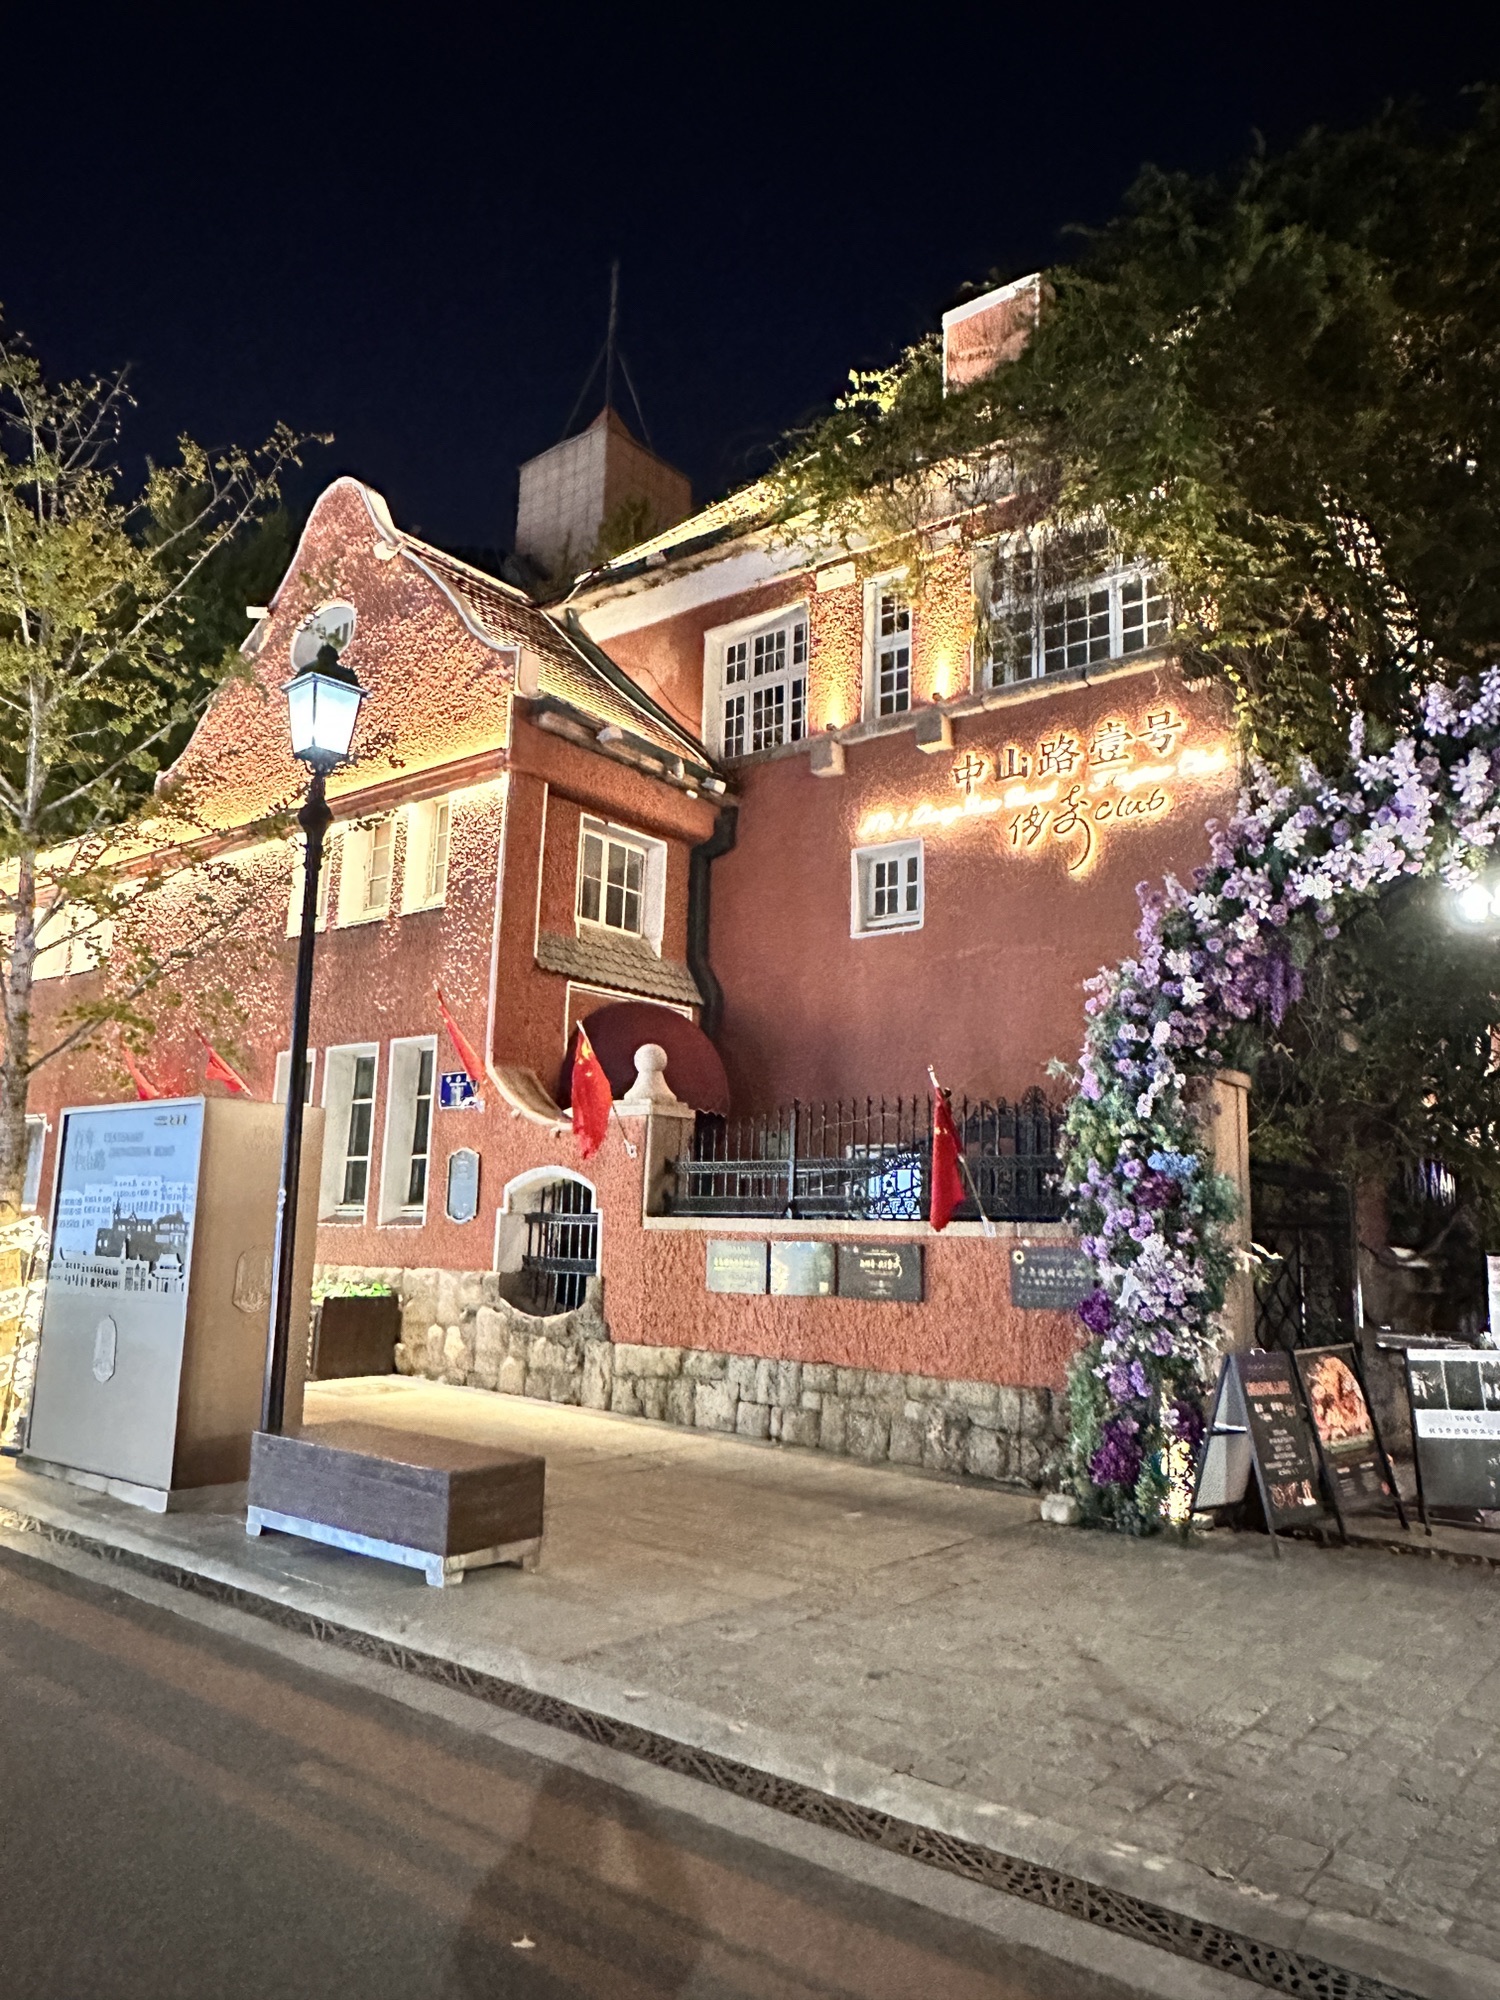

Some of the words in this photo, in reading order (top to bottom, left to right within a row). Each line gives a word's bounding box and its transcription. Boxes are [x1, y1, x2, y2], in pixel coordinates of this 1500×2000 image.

[953, 710, 1182, 793] 中山路壹号
